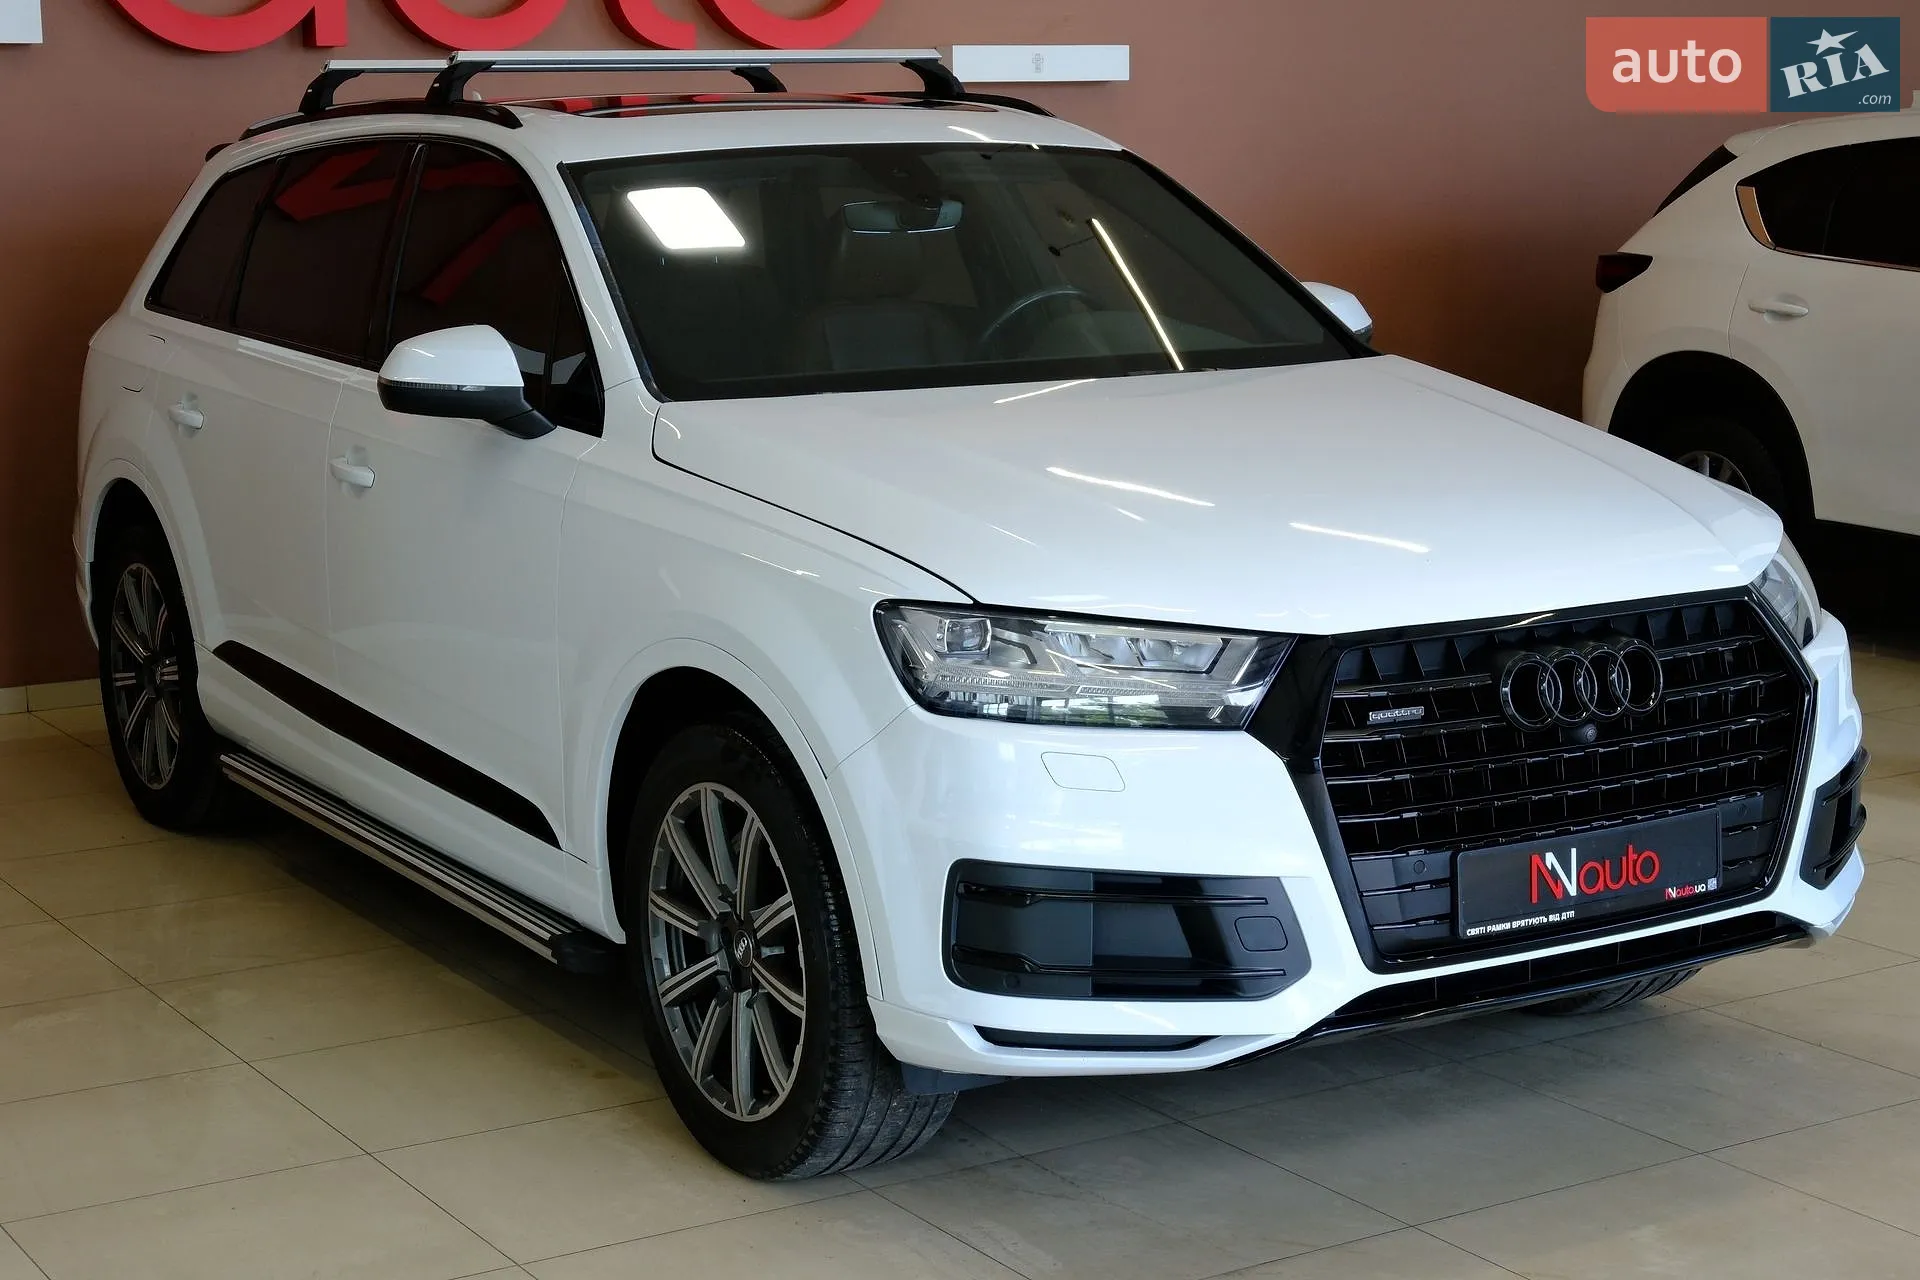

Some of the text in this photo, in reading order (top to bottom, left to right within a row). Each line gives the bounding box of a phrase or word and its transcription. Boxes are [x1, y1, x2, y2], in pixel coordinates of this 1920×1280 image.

[1466, 910, 1575, 936] СВЯТІ РАМКИ ВРЯТУЮТЬ ВІД ДТП
